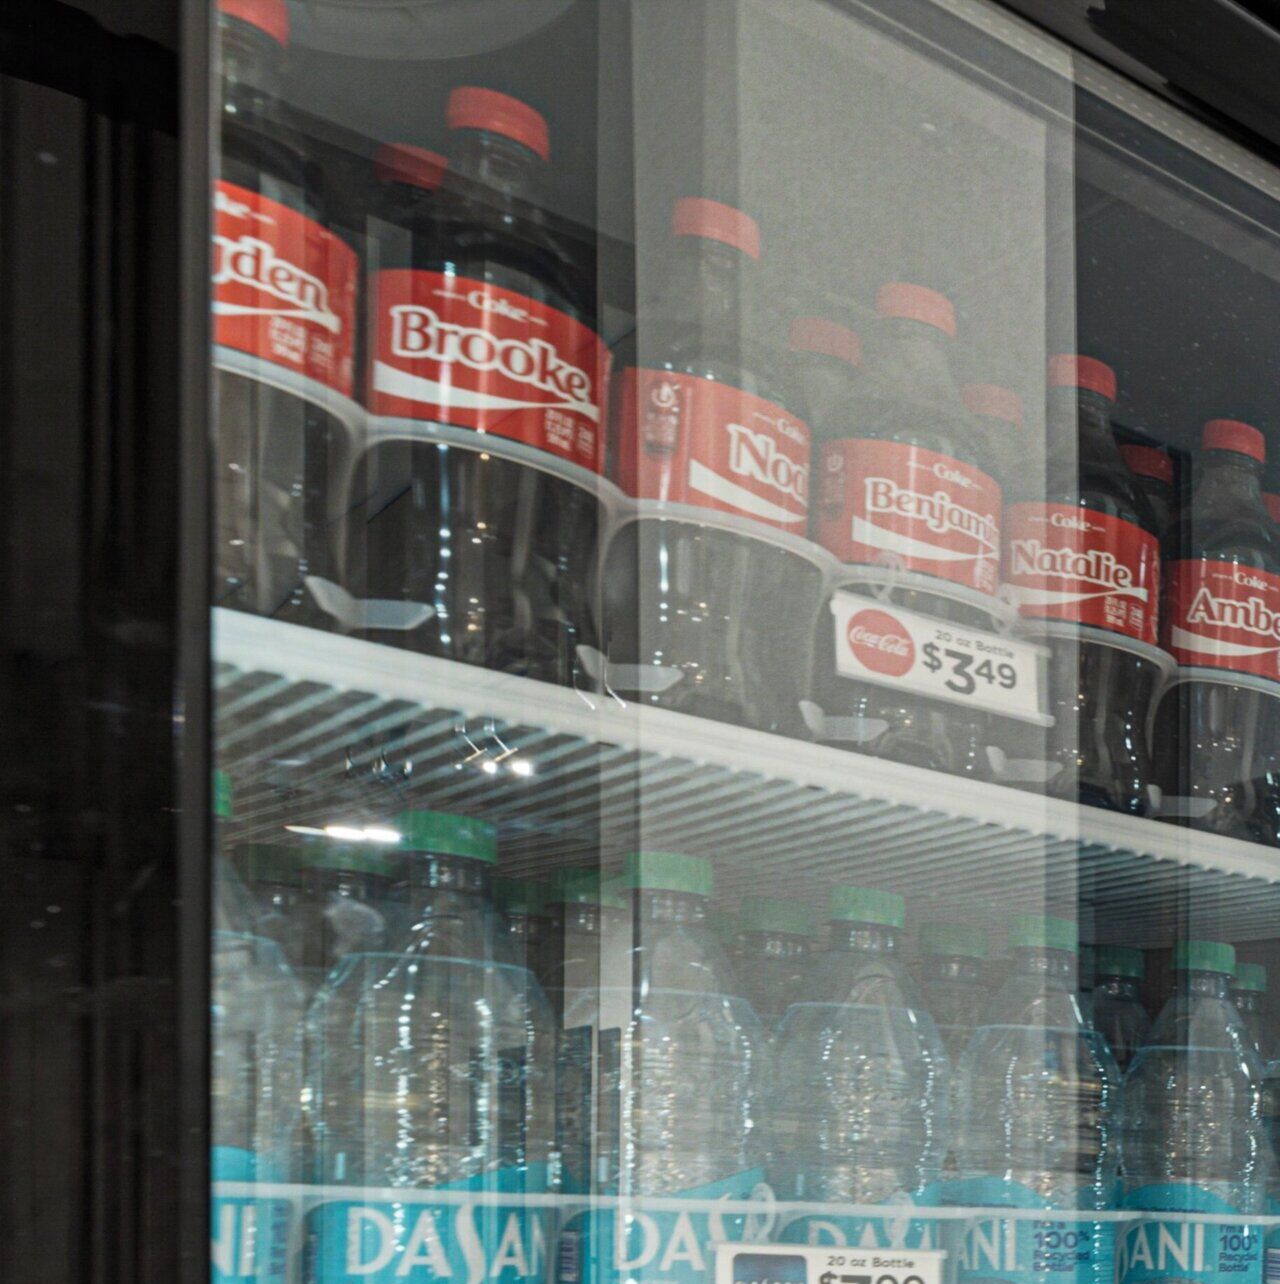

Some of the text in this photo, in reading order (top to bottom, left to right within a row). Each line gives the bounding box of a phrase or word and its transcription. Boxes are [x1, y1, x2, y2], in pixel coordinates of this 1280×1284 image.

[389, 304, 592, 406] Brooke
[1050, 512, 1092, 532] Coke
[1010, 538, 1133, 591] Natalie
[1235, 571, 1269, 592] Coke
[827, 1255, 916, 1269] 20 oz Bottle
